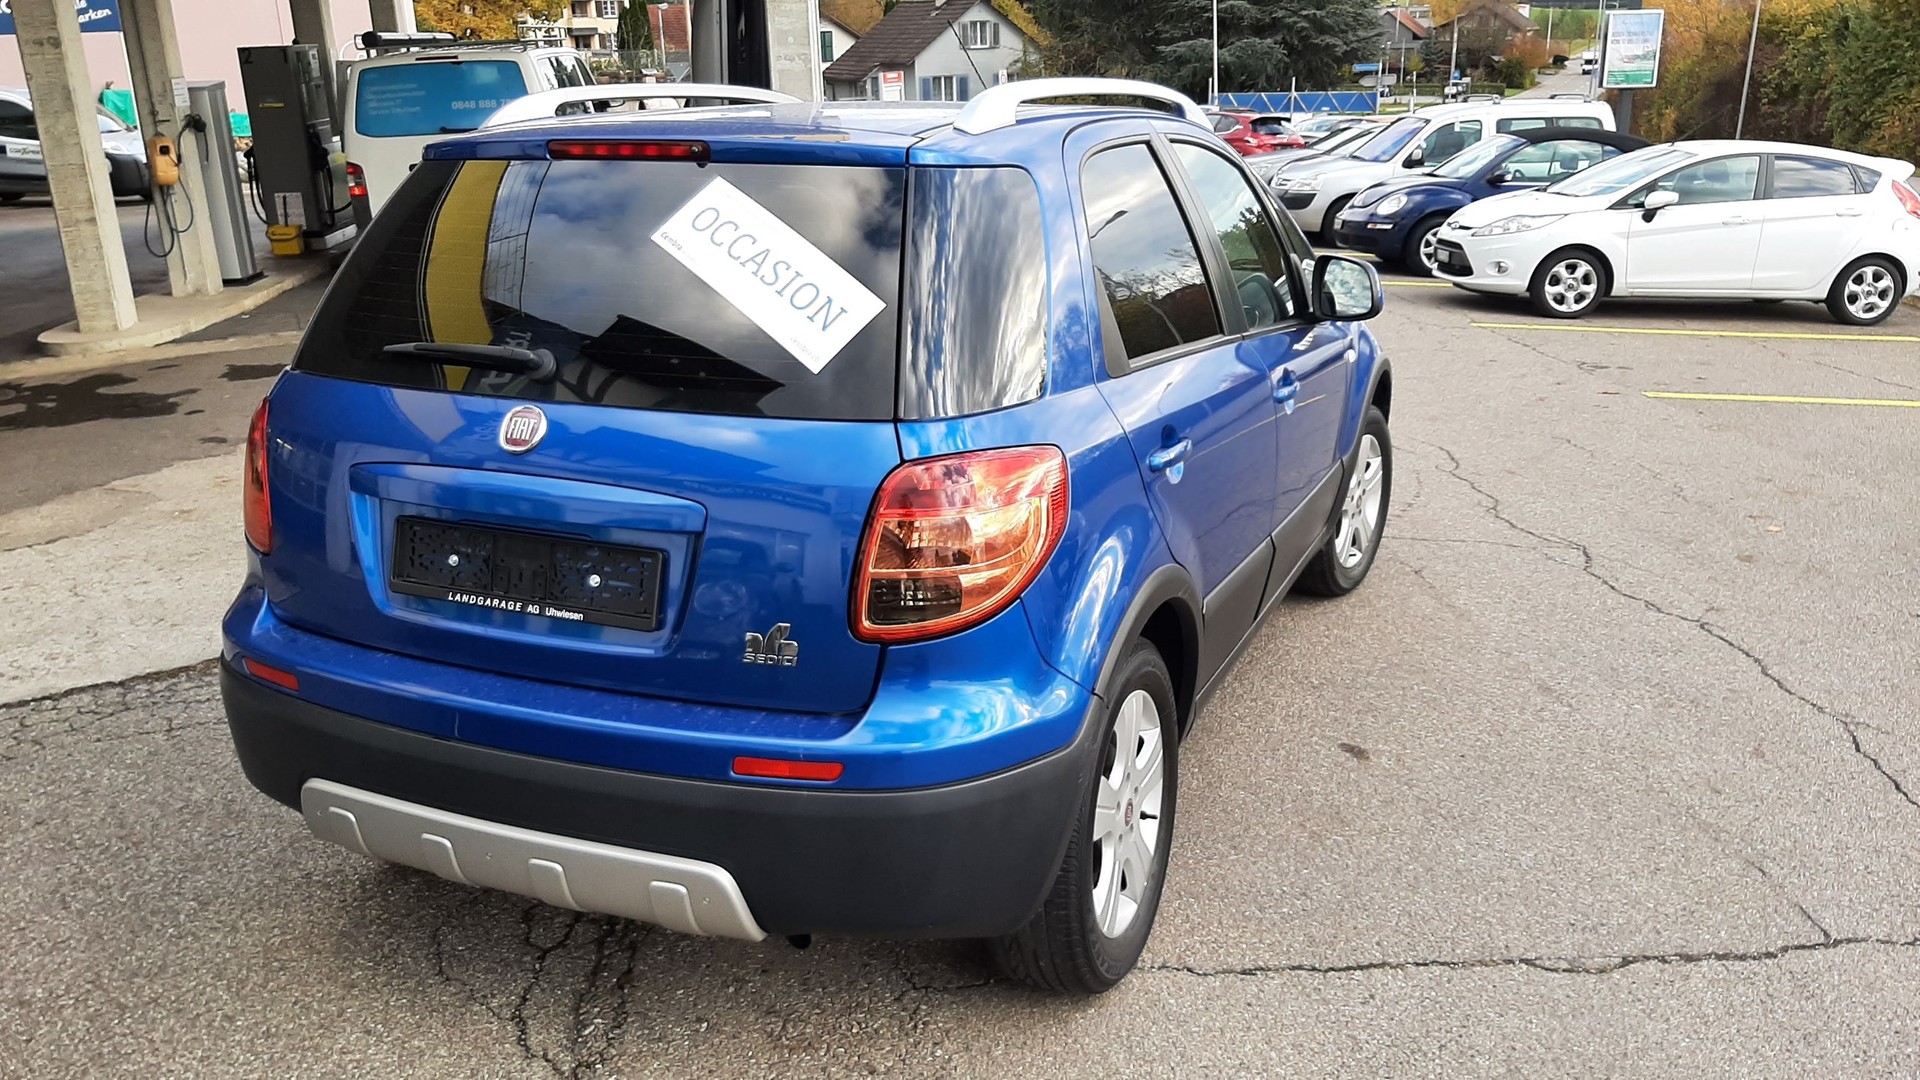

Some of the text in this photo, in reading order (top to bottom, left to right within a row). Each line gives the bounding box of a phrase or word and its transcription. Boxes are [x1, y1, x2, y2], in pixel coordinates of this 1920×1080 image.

[78, 9, 112, 23] arken
[241, 49, 253, 64] 2
[452, 100, 476, 110] 0848
[478, 99, 497, 108] 888
[691, 207, 848, 332] OCCASION
[507, 417, 537, 440] FIAT
[448, 591, 584, 621] LANDGARAGE AG Uhwiesen
[742, 652, 798, 666] SEDICI
